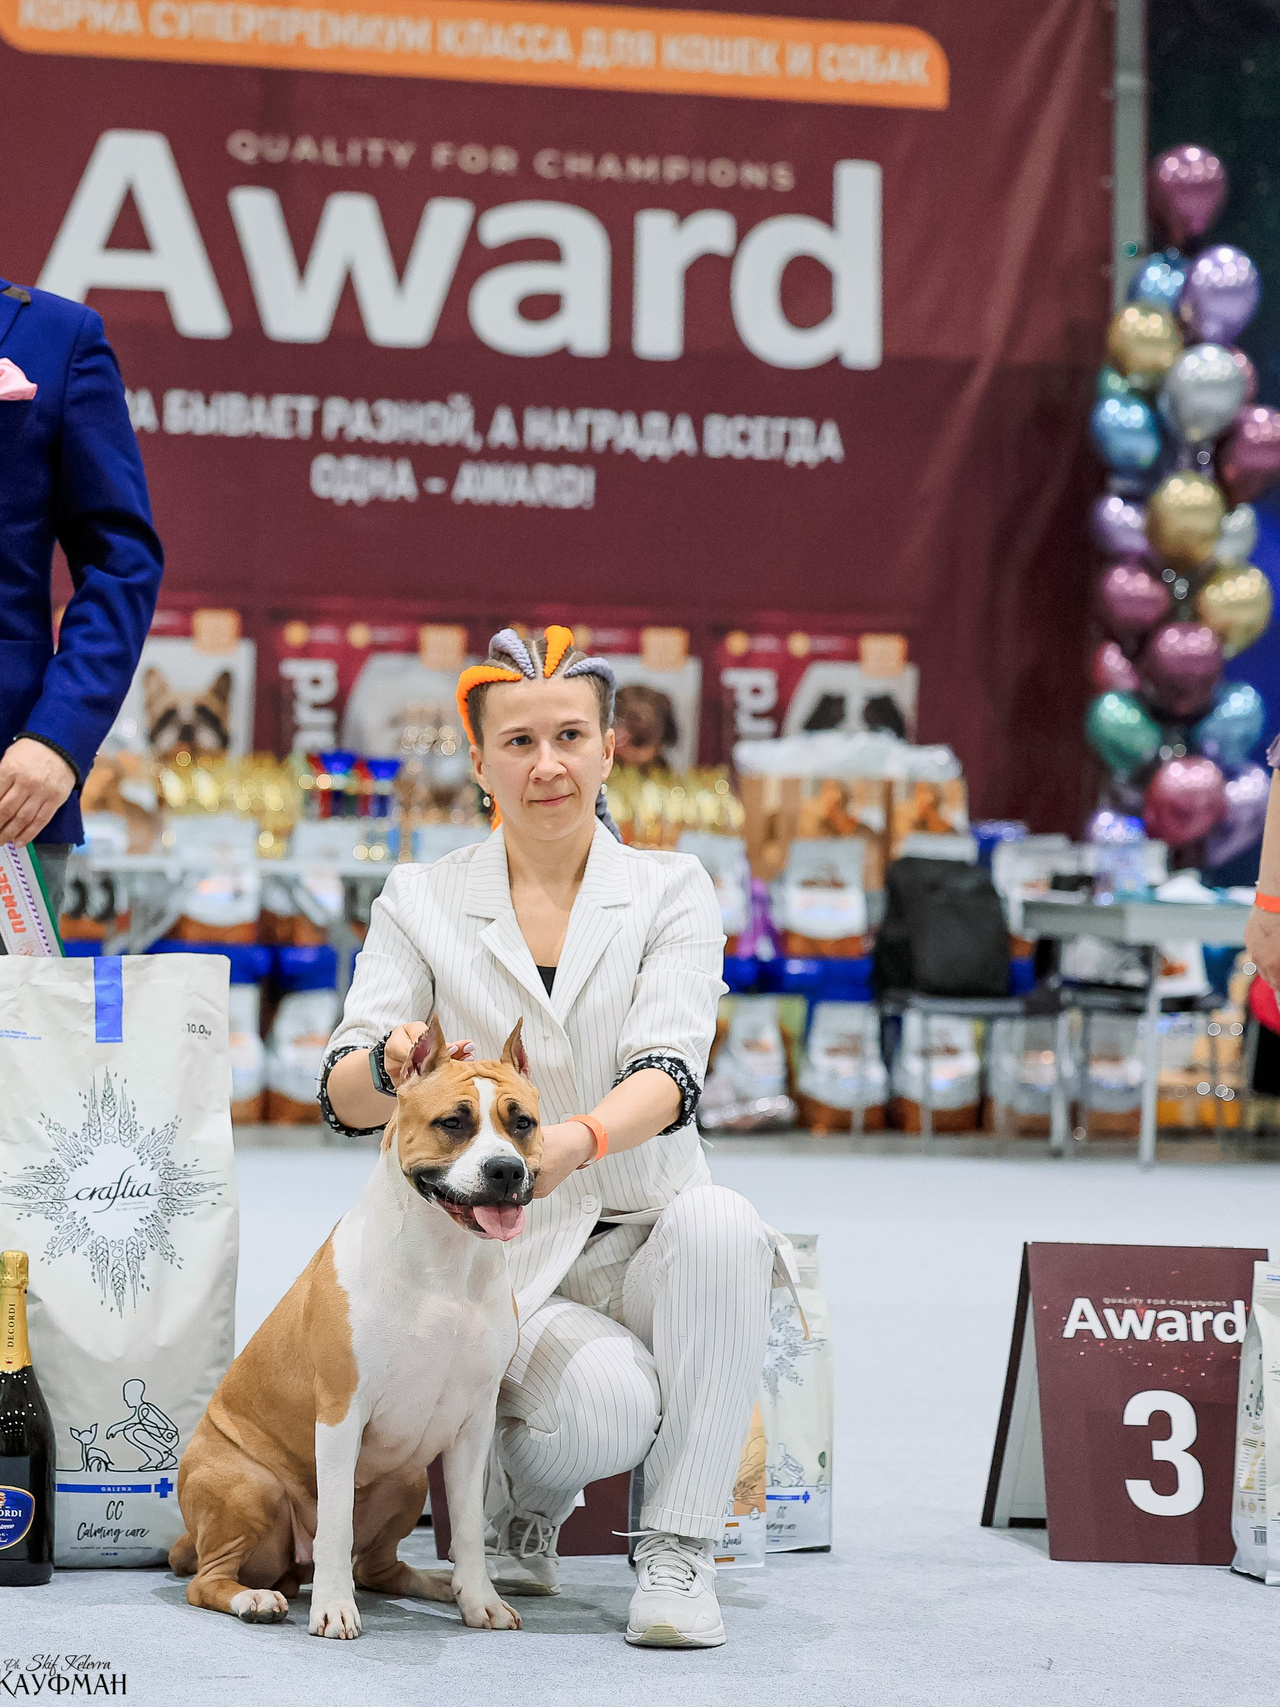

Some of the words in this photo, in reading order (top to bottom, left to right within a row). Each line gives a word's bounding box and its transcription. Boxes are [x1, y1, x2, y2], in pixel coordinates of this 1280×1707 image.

[148, 1, 431, 53] СУПЕРПРЕМИУМ
[437, 18, 574, 63] КЛАССА
[578, 26, 656, 71] ДЛЯ
[661, 33, 781, 77] КОШЕК
[785, 41, 813, 79] И
[819, 43, 930, 85] СОБАК
[226, 129, 417, 168] QUALITY
[431, 140, 519, 177] FOR
[532, 147, 795, 192] CHAMPIONS
[36, 129, 883, 371] Award
[162, 388, 318, 440] БЫВАЕТ
[322, 391, 483, 453] РАЗНОЙ,
[486, 404, 518, 450] А
[522, 405, 699, 462] НАГРАДА
[702, 412, 845, 469] ВСЕГДА
[310, 452, 418, 506] ОДНА
[58, 1164, 170, 1214] craftia
[7, 1303, 16, 1348] DECORDI
[1062, 1297, 1248, 1344] Award
[1102, 1296, 1144, 1305] QUALITY
[1147, 1298, 1167, 1306] FOR
[1122, 1389, 1206, 1518] 3
[77, 1522, 124, 1543] Calming
[125, 1527, 150, 1538] care
[106, 1500, 124, 1520] CC
